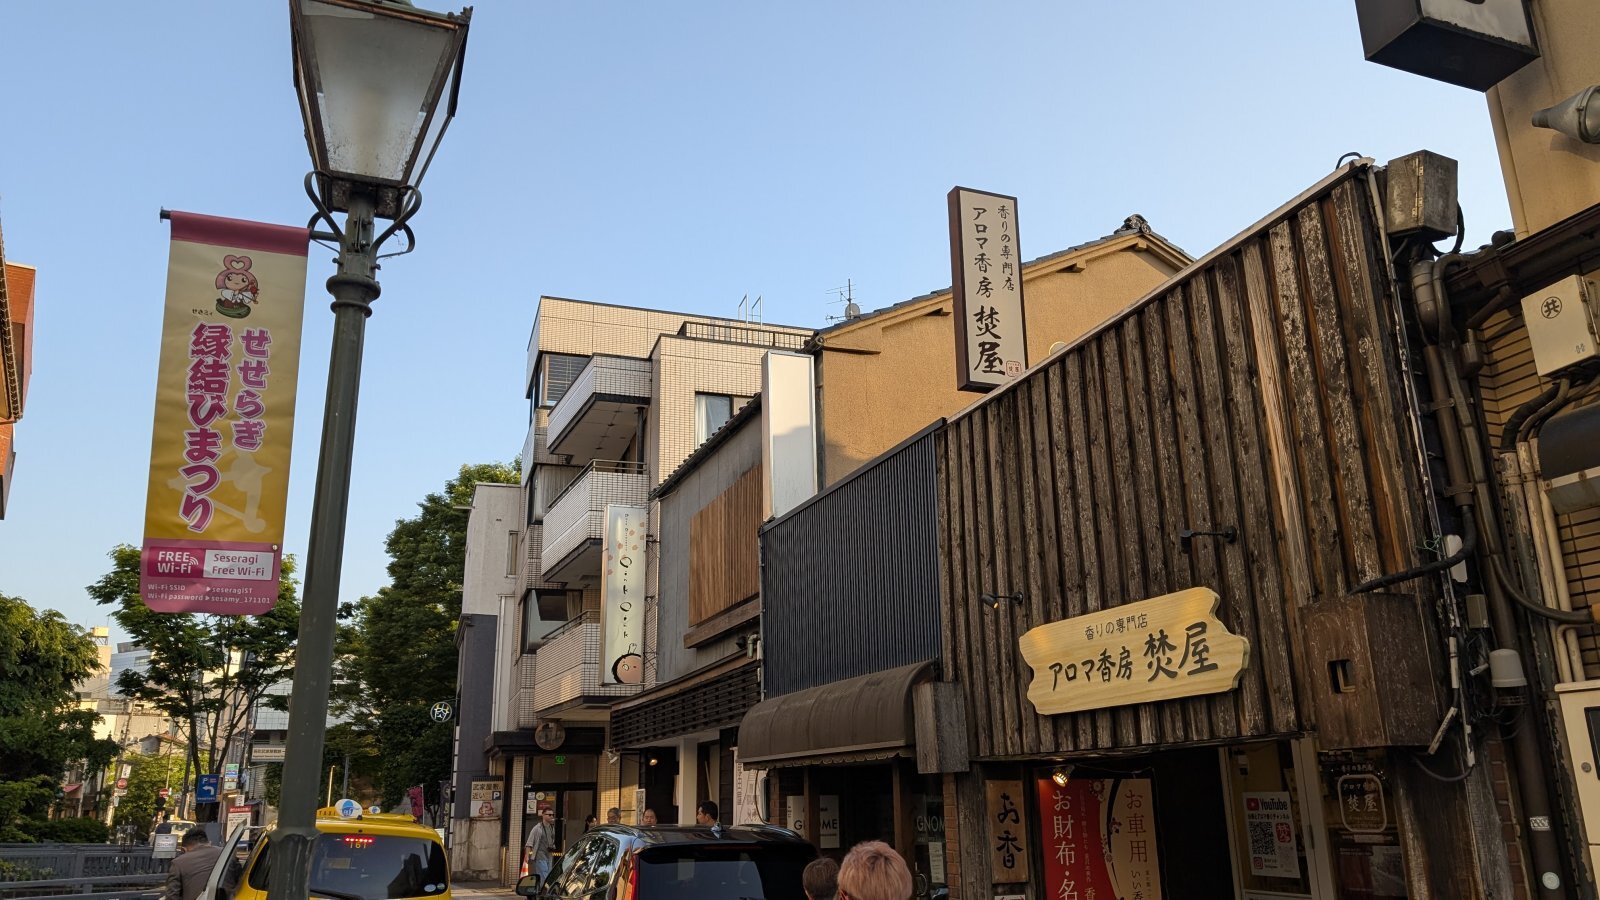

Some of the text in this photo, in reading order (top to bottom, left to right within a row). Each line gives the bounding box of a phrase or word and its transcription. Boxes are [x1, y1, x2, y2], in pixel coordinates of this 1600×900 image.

[972, 207, 994, 299] アロマ香房
[997, 205, 1015, 292] 香りの専門店
[231, 328, 272, 450] せせらぎ
[179, 322, 233, 534] 縁結びまつり
[157, 563, 191, 574] Wi-Fi
[158, 551, 190, 562] FREE
[212, 566, 265, 576] Free Wi-Fi
[213, 553, 259, 565] Seseragi
[211, 596, 270, 604] sesamy_171101
[1085, 613, 1148, 640] 香りの専門店
[1049, 646, 1133, 692] アロマ香房
[493, 791, 500, 800] P
[1259, 798, 1288, 811] YouTube
[996, 792, 1024, 870] お香
[1124, 789, 1148, 863] お車用
[1052, 790, 1078, 900] お財布・名
